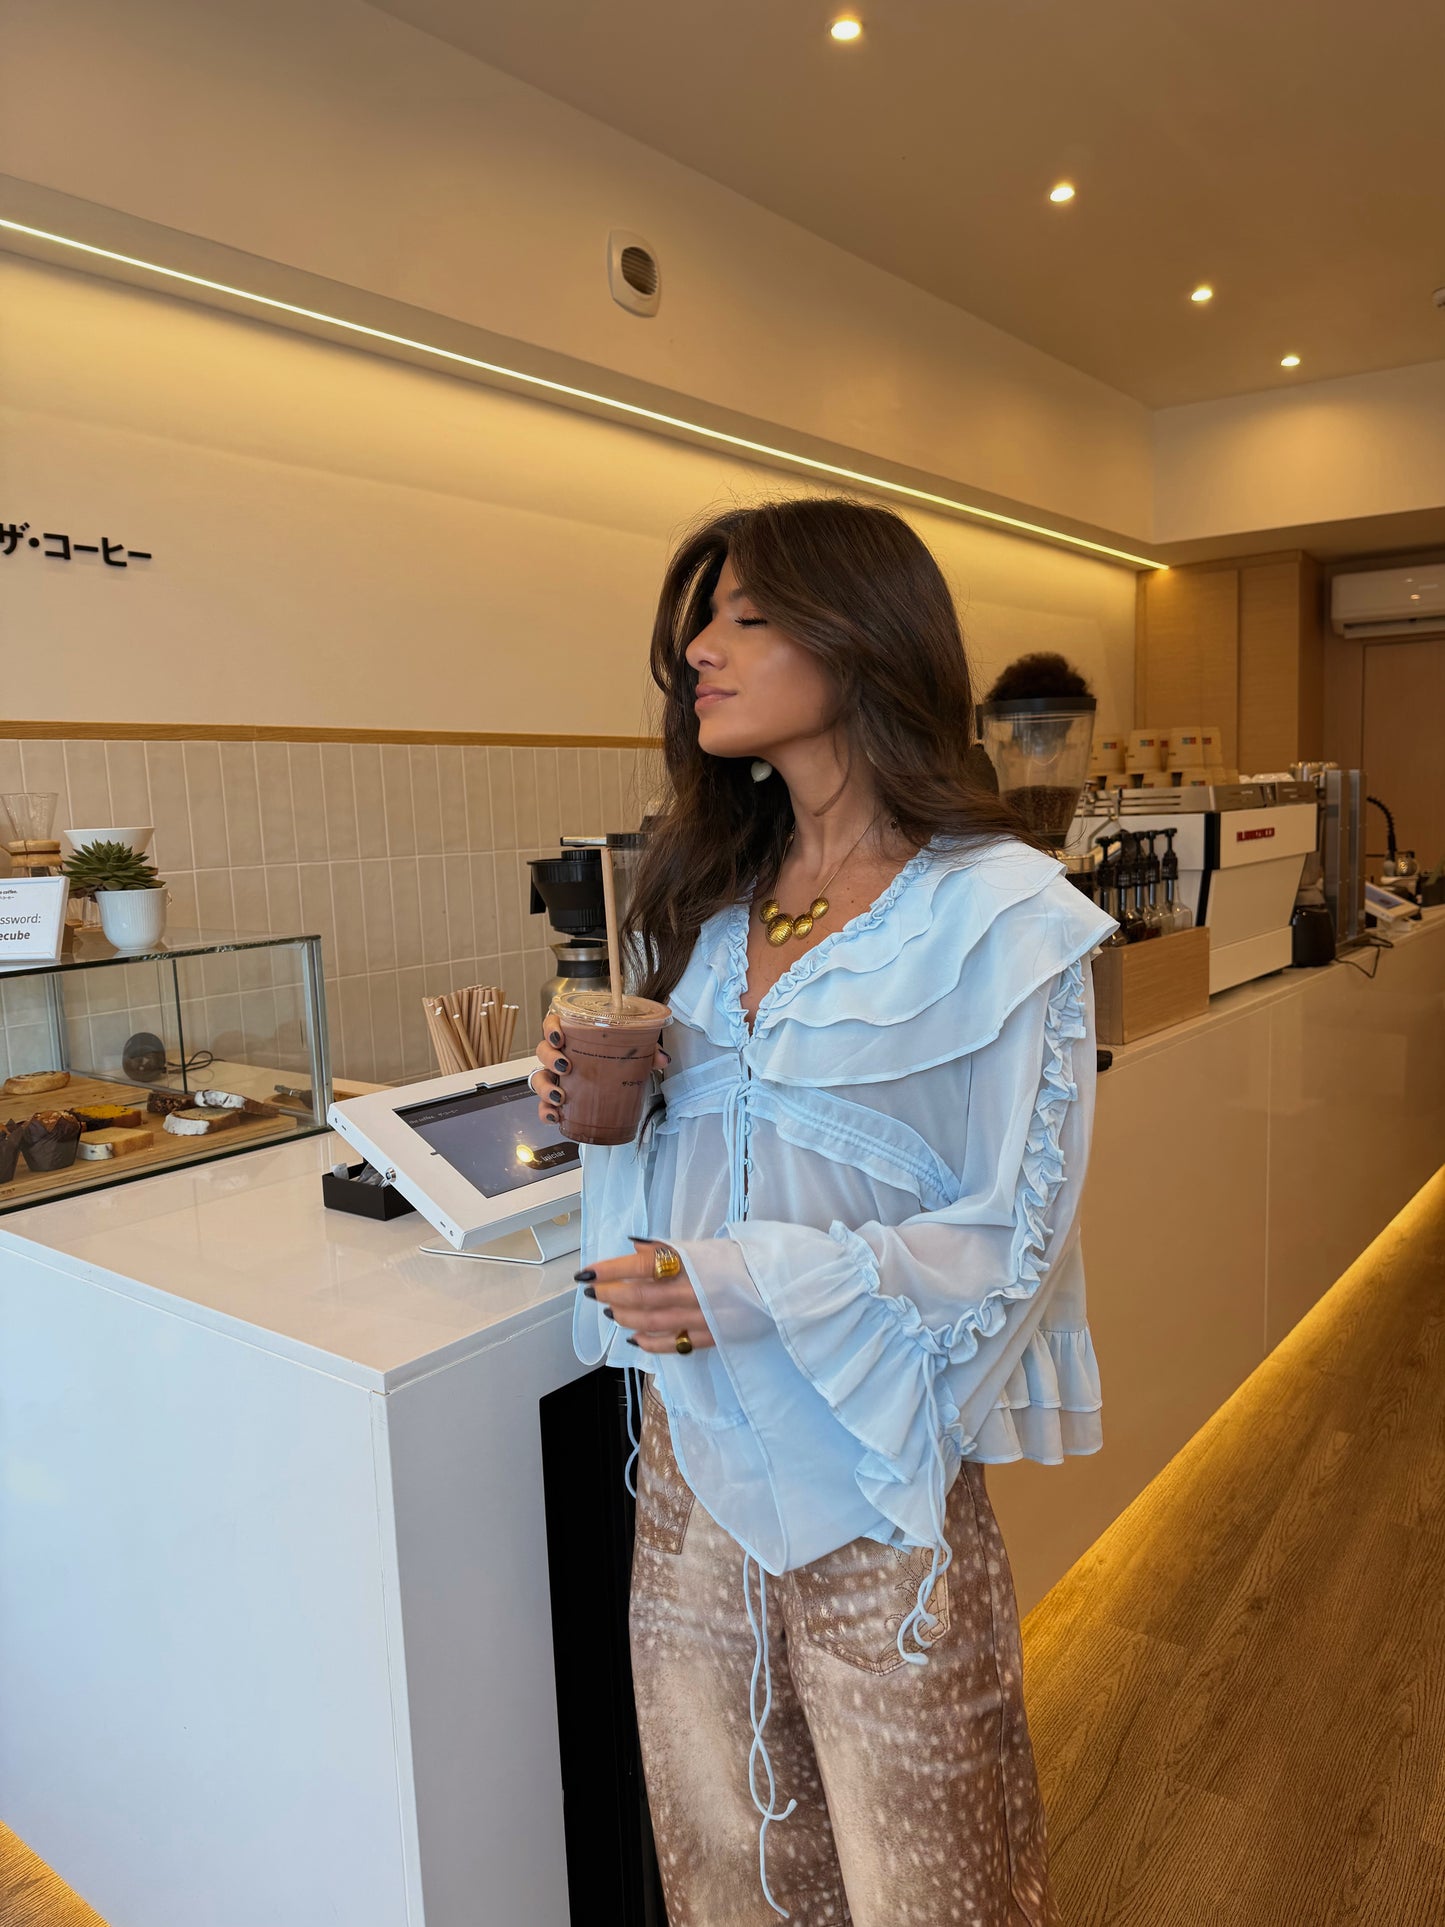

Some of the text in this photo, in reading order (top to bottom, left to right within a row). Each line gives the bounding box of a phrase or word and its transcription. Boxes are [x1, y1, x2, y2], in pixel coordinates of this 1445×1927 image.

[0, 522, 152, 568] ザ・コーヒー
